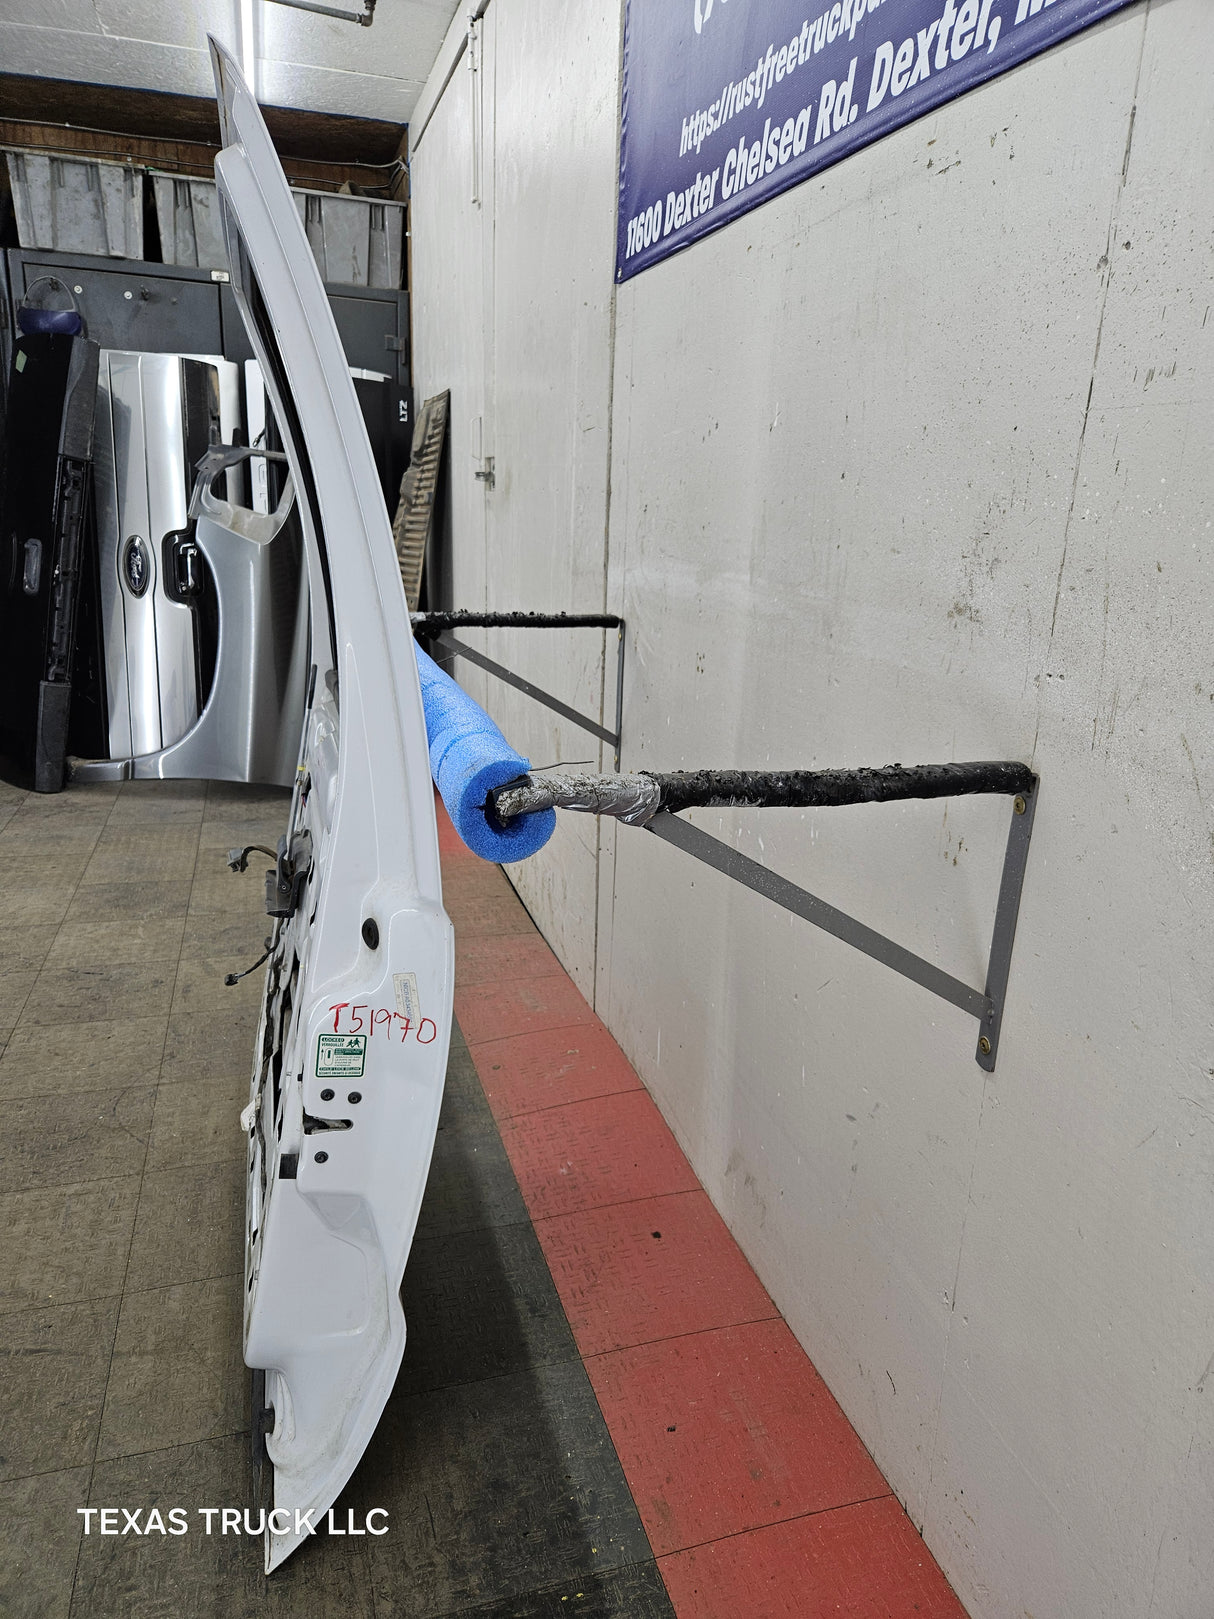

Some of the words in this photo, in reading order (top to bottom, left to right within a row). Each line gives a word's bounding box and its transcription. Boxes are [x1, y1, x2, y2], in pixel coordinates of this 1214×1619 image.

[626, 200, 662, 259] 11600
[663, 171, 720, 236] Dexter
[721, 104, 812, 200] Chelsea
[814, 56, 858, 145] Rd.
[866, 0, 1001, 113] Dexter,
[329, 1002, 437, 1044] T51970
